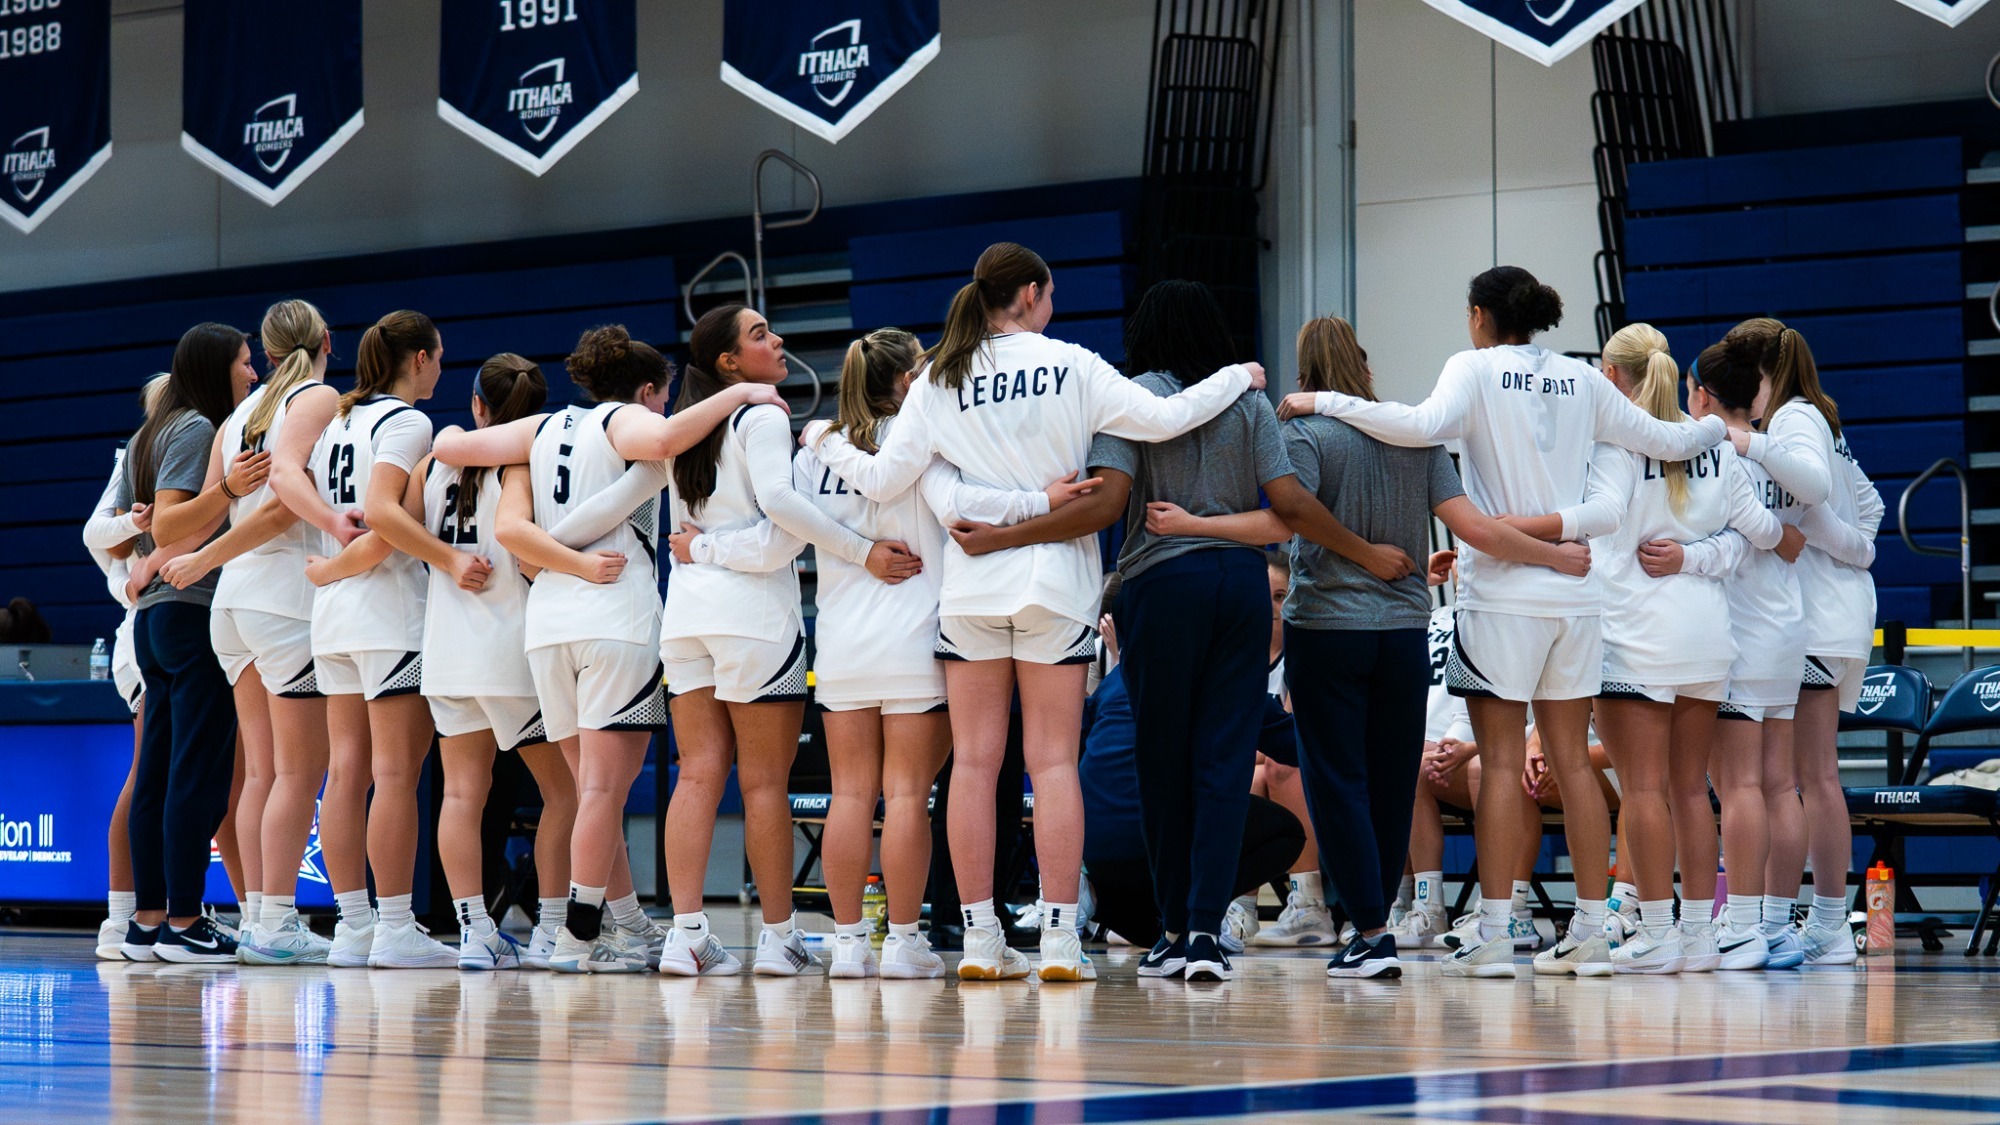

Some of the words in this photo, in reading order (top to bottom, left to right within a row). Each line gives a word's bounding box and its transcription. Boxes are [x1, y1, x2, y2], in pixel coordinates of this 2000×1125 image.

[499, 0, 577, 31] 1991
[0, 22, 61, 58] 1988
[798, 45, 869, 76] ITHACA
[811, 69, 857, 84] BOMBERS
[508, 82, 572, 112] ITHACA
[520, 105, 560, 119] BOMBERS
[244, 116, 304, 144] ITHACA
[3, 149, 56, 174] ITHACA
[957, 366, 1069, 412] LEGACY
[1502, 371, 1533, 391] ONE
[1542, 377, 1575, 396] BOAT
[328, 443, 356, 504] 42
[553, 443, 573, 504] 5
[1644, 448, 1720, 480] LACY
[1972, 681, 2000, 695] ITHA
[793, 798, 827, 809] ITHACA
[1874, 791, 1921, 804] ITHACA
[0, 813, 32, 848] ion
[0, 850, 29, 862] EVELOP
[32, 850, 72, 863] DEDICATE
